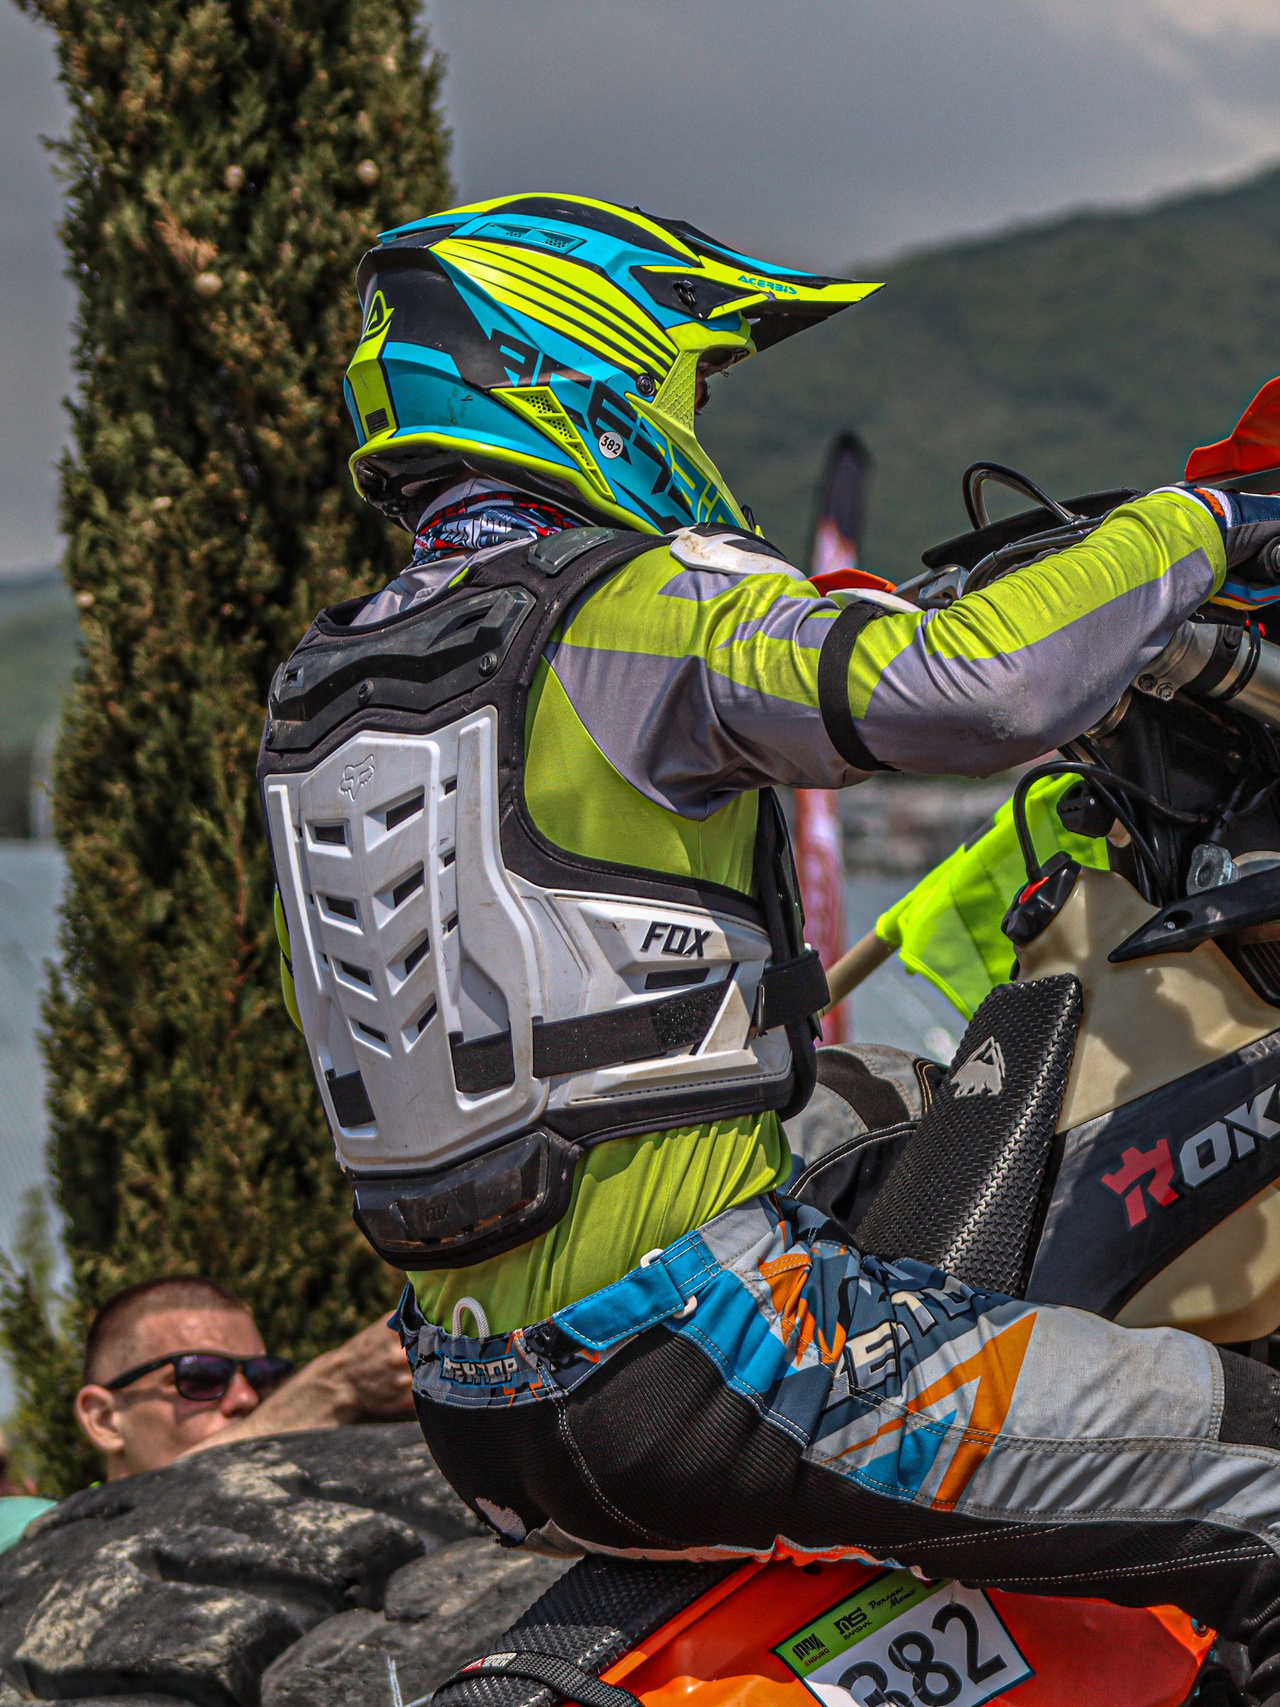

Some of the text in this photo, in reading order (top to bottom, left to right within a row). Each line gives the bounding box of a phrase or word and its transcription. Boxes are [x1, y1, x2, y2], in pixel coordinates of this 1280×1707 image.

[601, 437, 622, 454] 382
[640, 921, 712, 958] FOX
[804, 1648, 830, 1667] ENDURO
